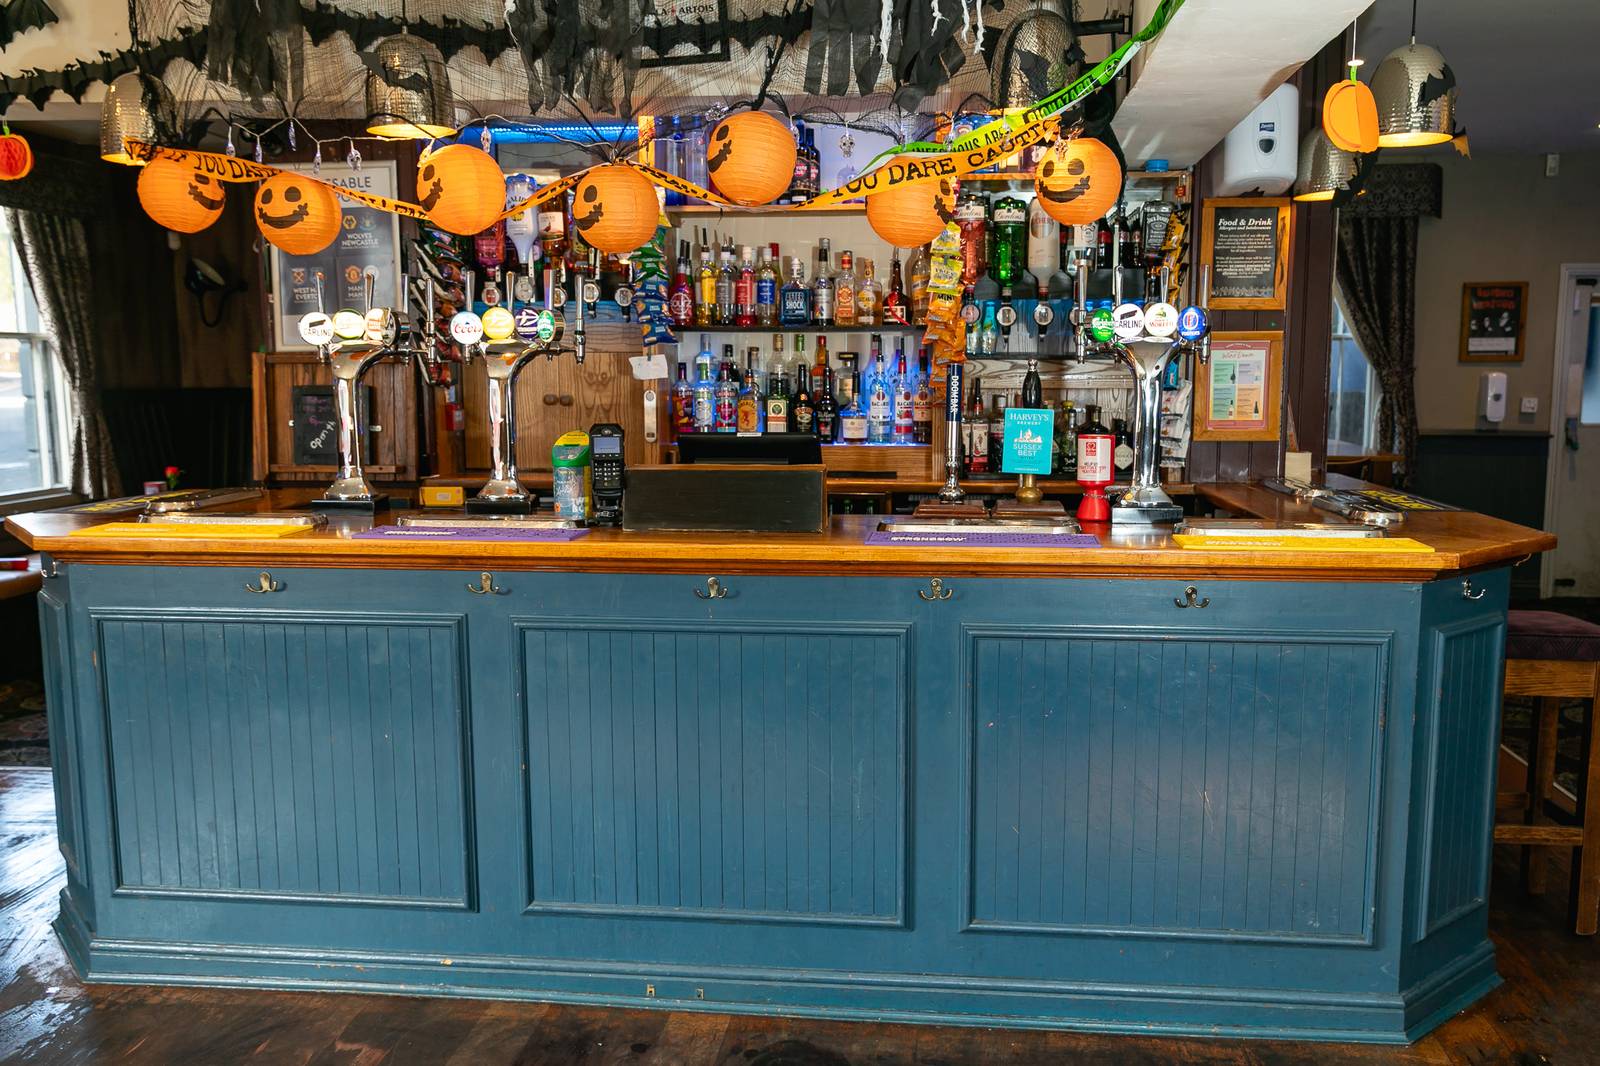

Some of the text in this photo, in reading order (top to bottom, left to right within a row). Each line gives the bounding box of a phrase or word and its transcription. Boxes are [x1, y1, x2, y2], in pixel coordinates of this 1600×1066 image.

[680, 4, 714, 14] ARTOIS
[888, 157, 957, 186] DARE
[1218, 218, 1238, 226] Food
[1247, 217, 1273, 226] Drink
[341, 239, 379, 247] NEWCASTLE
[785, 300, 805, 310] SHOCK
[1114, 318, 1143, 329] CARLING
[303, 327, 332, 338] CARLING
[1009, 412, 1049, 421] HARVEY'S
[1017, 449, 1038, 457] BEST
